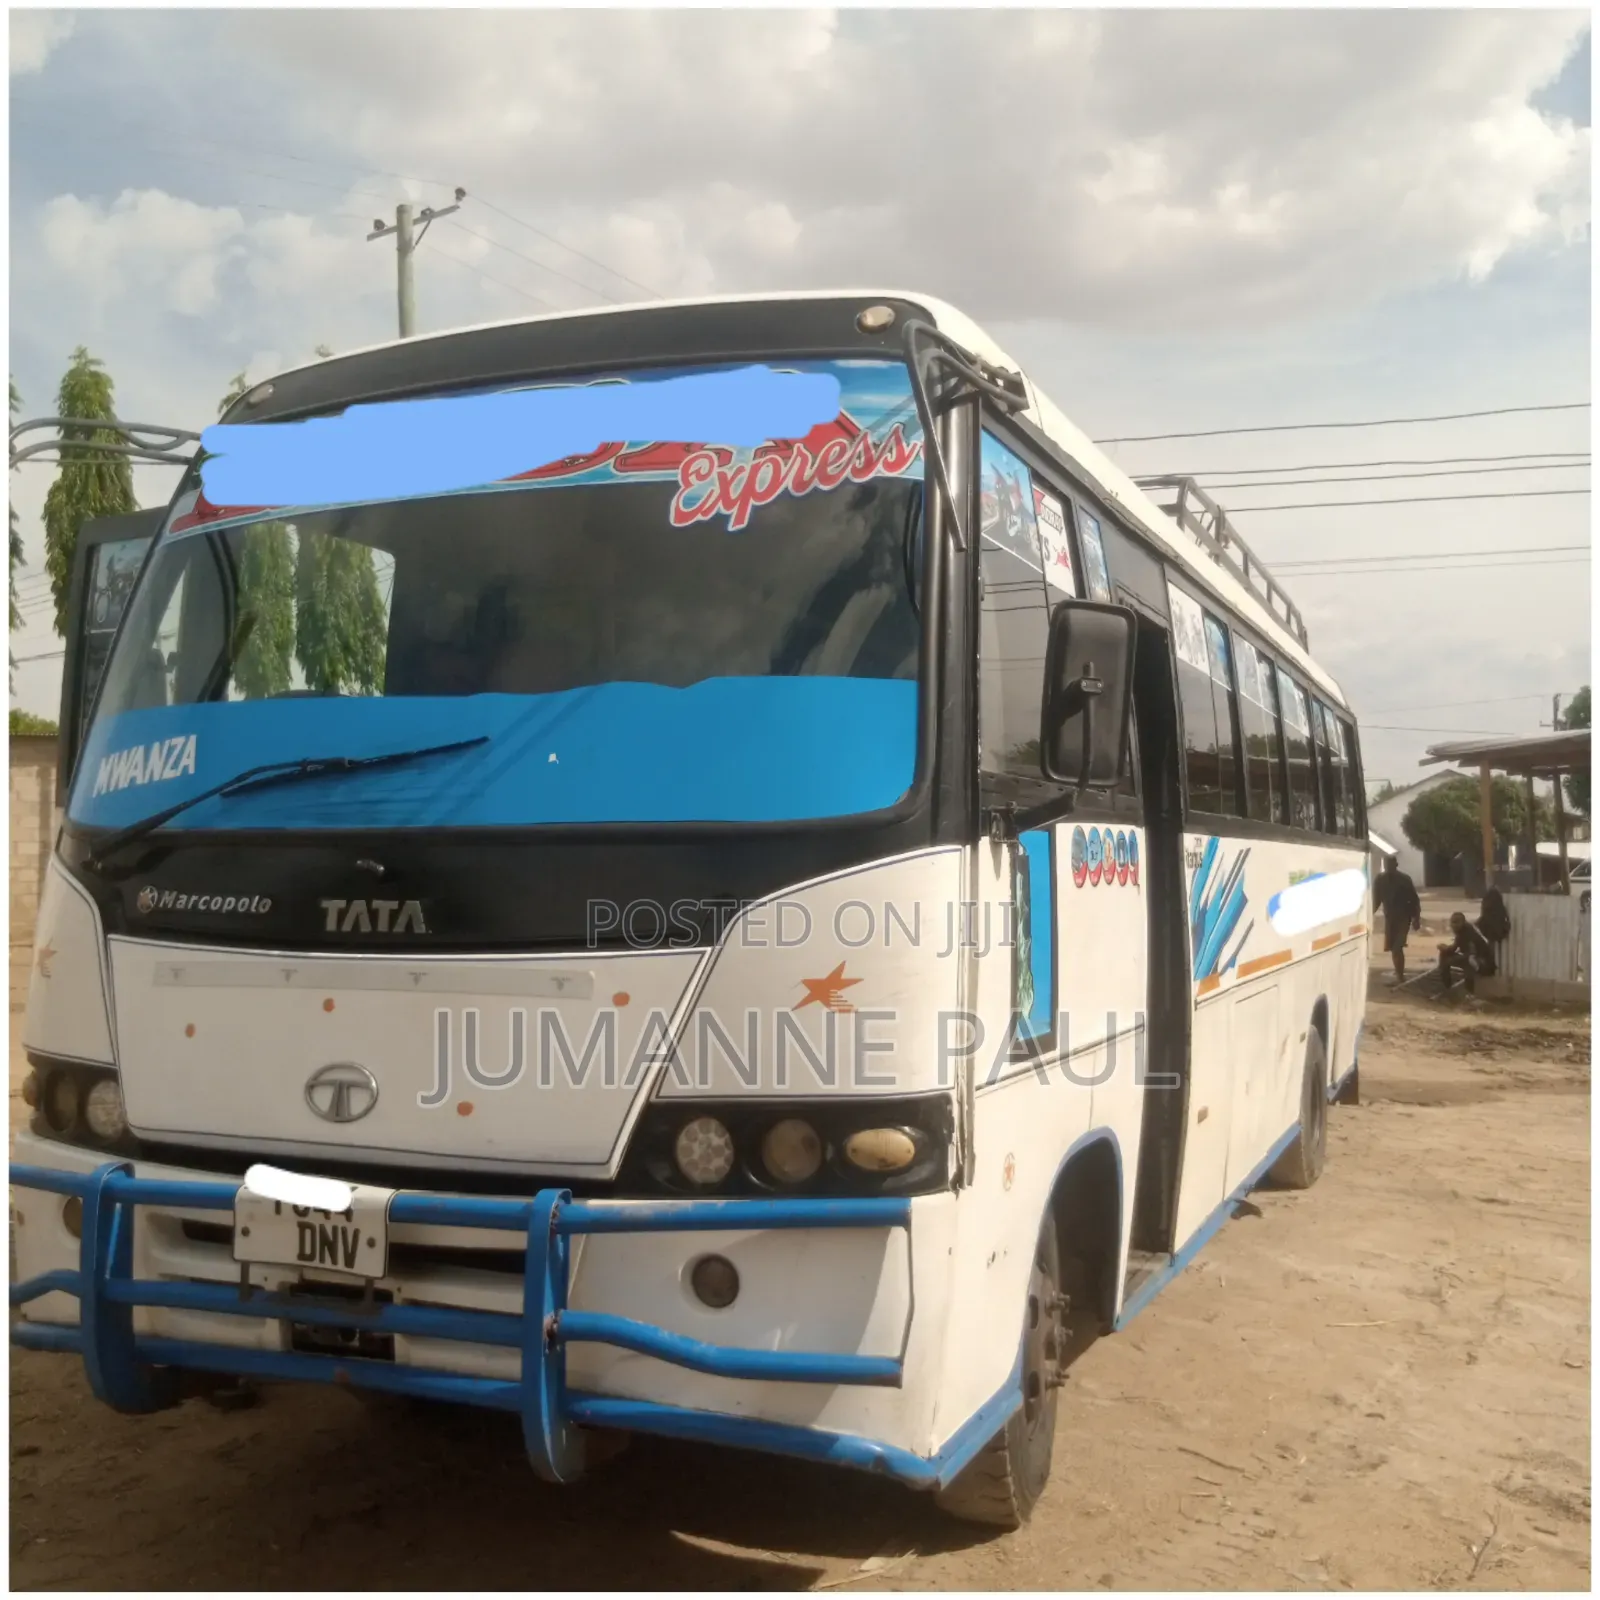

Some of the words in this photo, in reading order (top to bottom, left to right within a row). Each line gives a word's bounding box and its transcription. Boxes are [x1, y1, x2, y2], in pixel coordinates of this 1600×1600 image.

[671, 424, 918, 530] Express
[92, 734, 197, 797] MWANZA
[159, 890, 272, 915] Marcopolo
[321, 900, 426, 933] TATA
[296, 1220, 361, 1269] DNV
